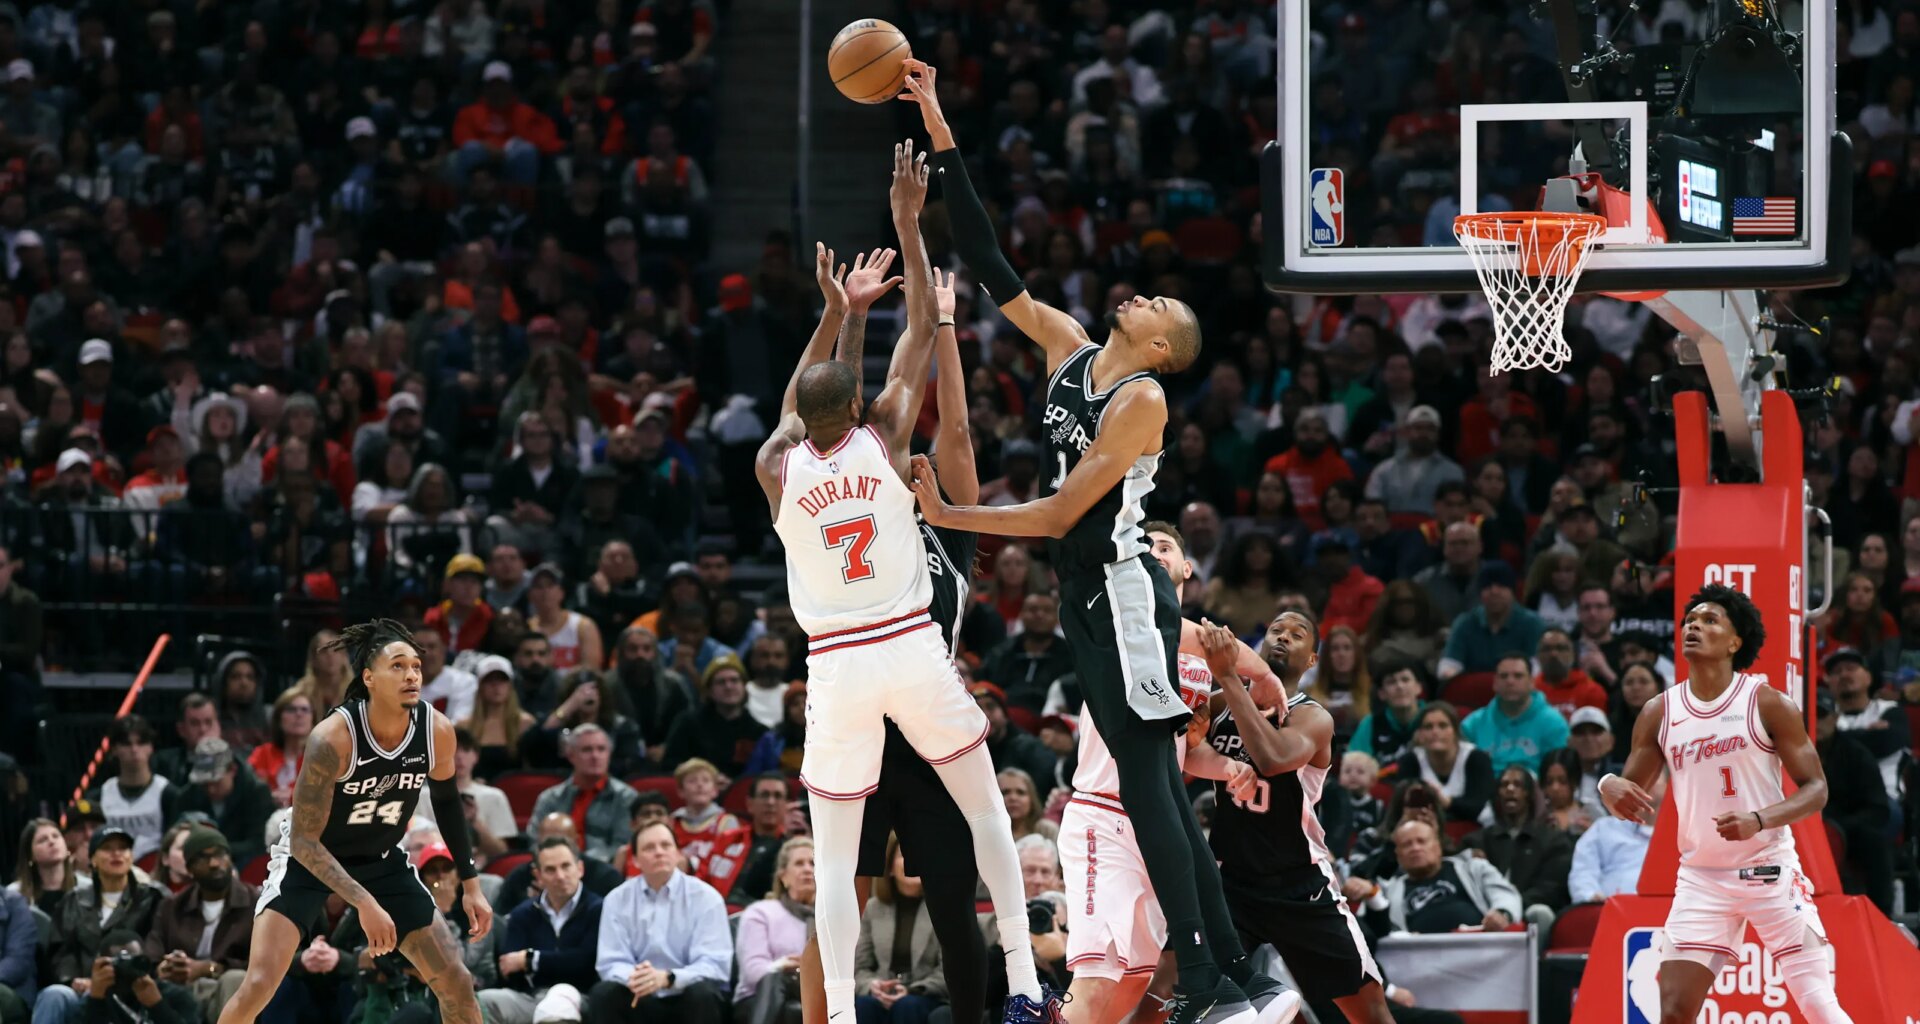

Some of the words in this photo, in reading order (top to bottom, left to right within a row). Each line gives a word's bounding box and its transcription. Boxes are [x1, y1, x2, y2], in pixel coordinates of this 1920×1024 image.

[1314, 228, 1331, 241] NBA
[1049, 450, 1068, 491] 1
[797, 475, 882, 518] DURANT
[820, 513, 878, 584] 7
[928, 552, 943, 576] S
[1670, 733, 1748, 771] H-Town
[342, 773, 427, 799] SPURS
[1226, 779, 1271, 814] 0
[1719, 766, 1738, 798] 1
[346, 800, 404, 826] 24
[1086, 828, 1097, 916] ROCKETS
